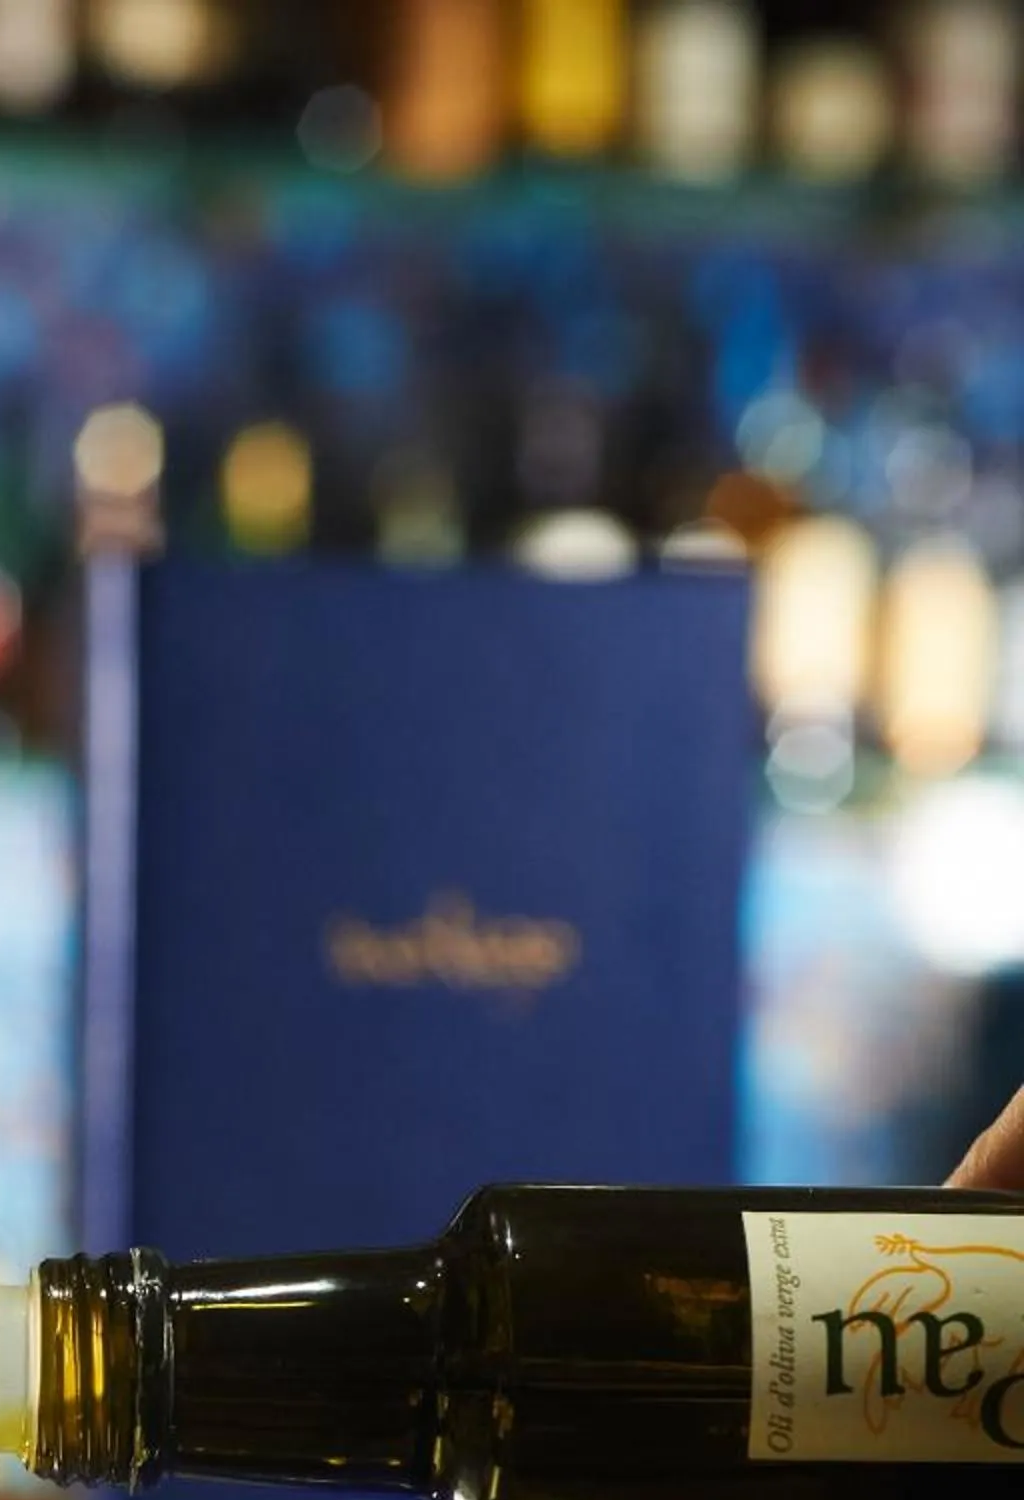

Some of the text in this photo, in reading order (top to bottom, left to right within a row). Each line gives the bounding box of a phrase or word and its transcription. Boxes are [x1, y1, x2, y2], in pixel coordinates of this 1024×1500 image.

[775, 1264, 801, 1320] verge
[769, 1323, 796, 1410] d'oliva
[767, 1413, 795, 1453] Oli
